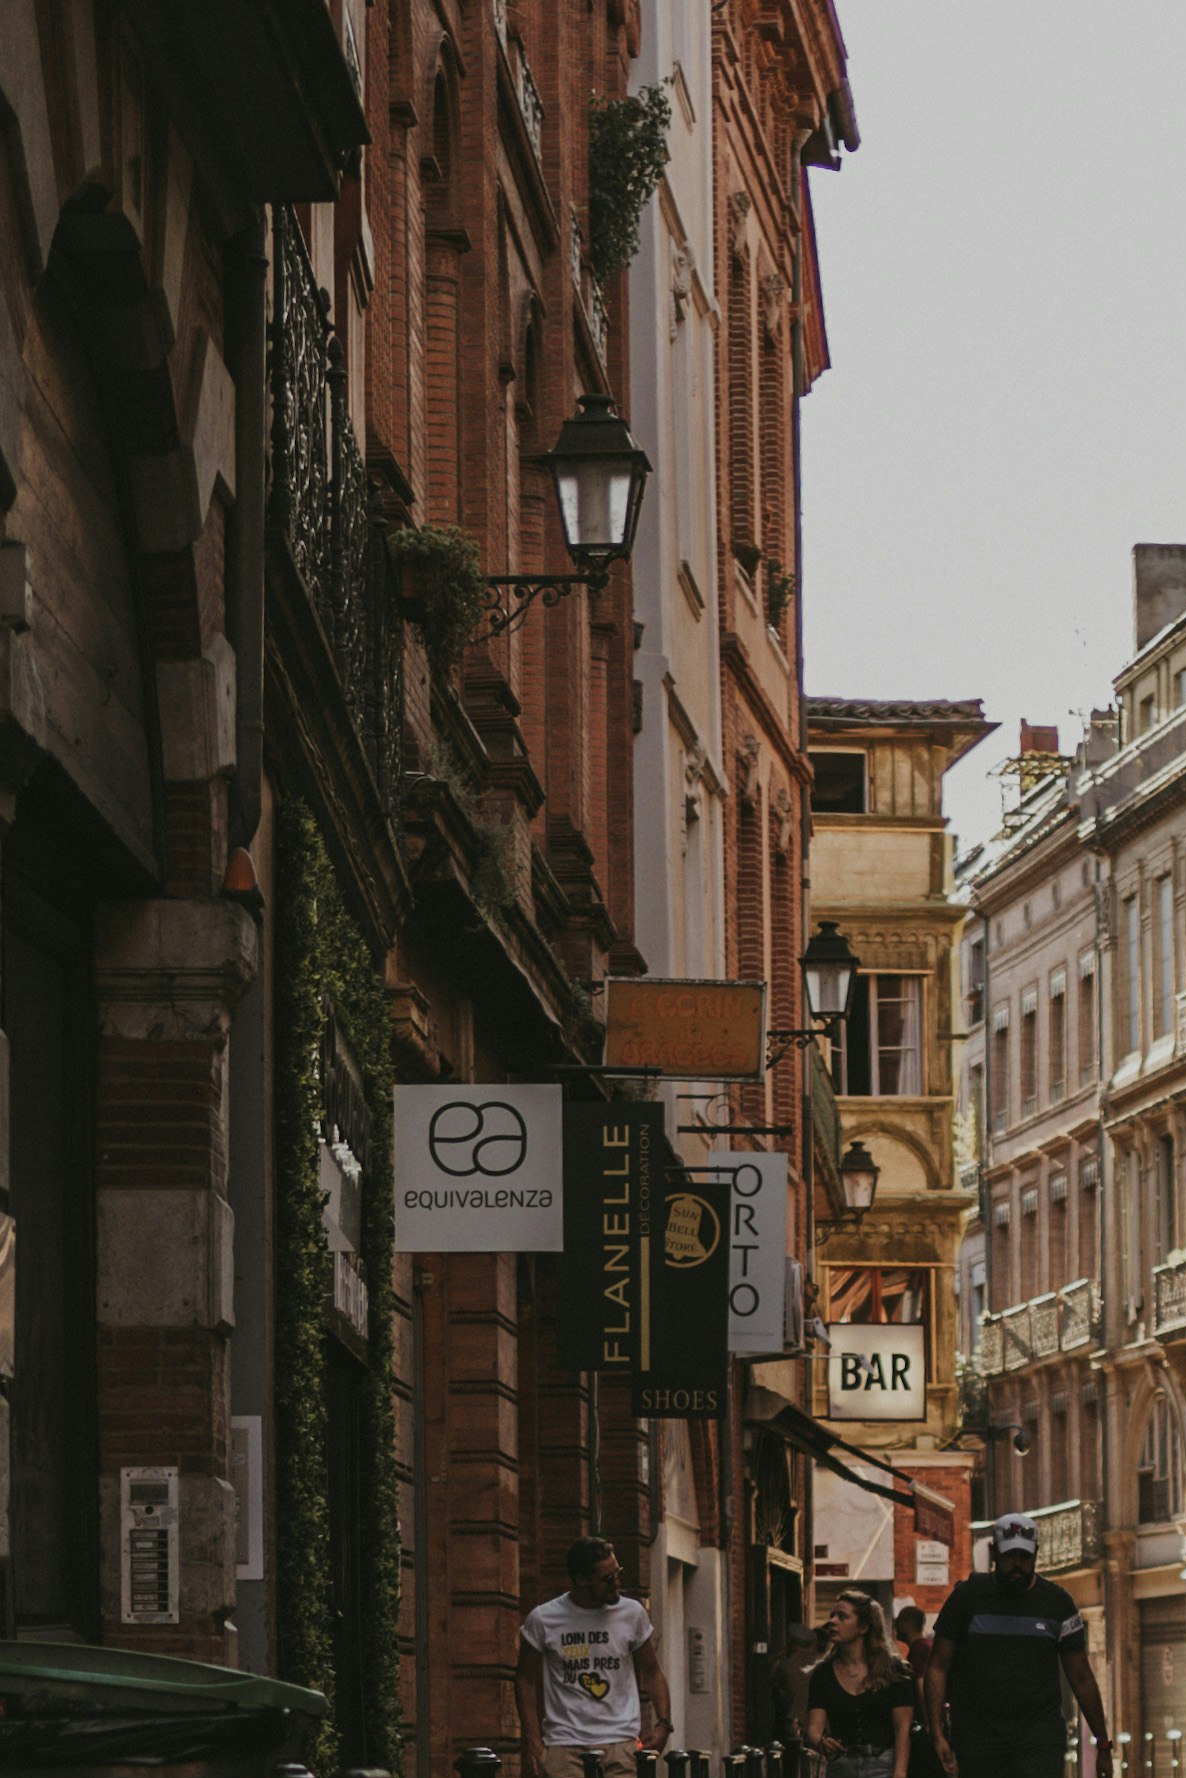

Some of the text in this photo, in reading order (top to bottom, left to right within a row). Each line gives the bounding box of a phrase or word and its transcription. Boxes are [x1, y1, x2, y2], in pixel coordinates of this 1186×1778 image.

[638, 1123, 651, 1234] DÉCORATION
[673, 1206, 698, 1221] SUN
[669, 1222, 698, 1236] BELL
[603, 1124, 631, 1362] FLANELLE
[840, 1352, 912, 1392] BAR
[641, 1388, 718, 1411] SHOES
[561, 1631, 609, 1646] LOIN DES
[563, 1657, 590, 1670] MAIS
[563, 1671, 577, 1683] DU
